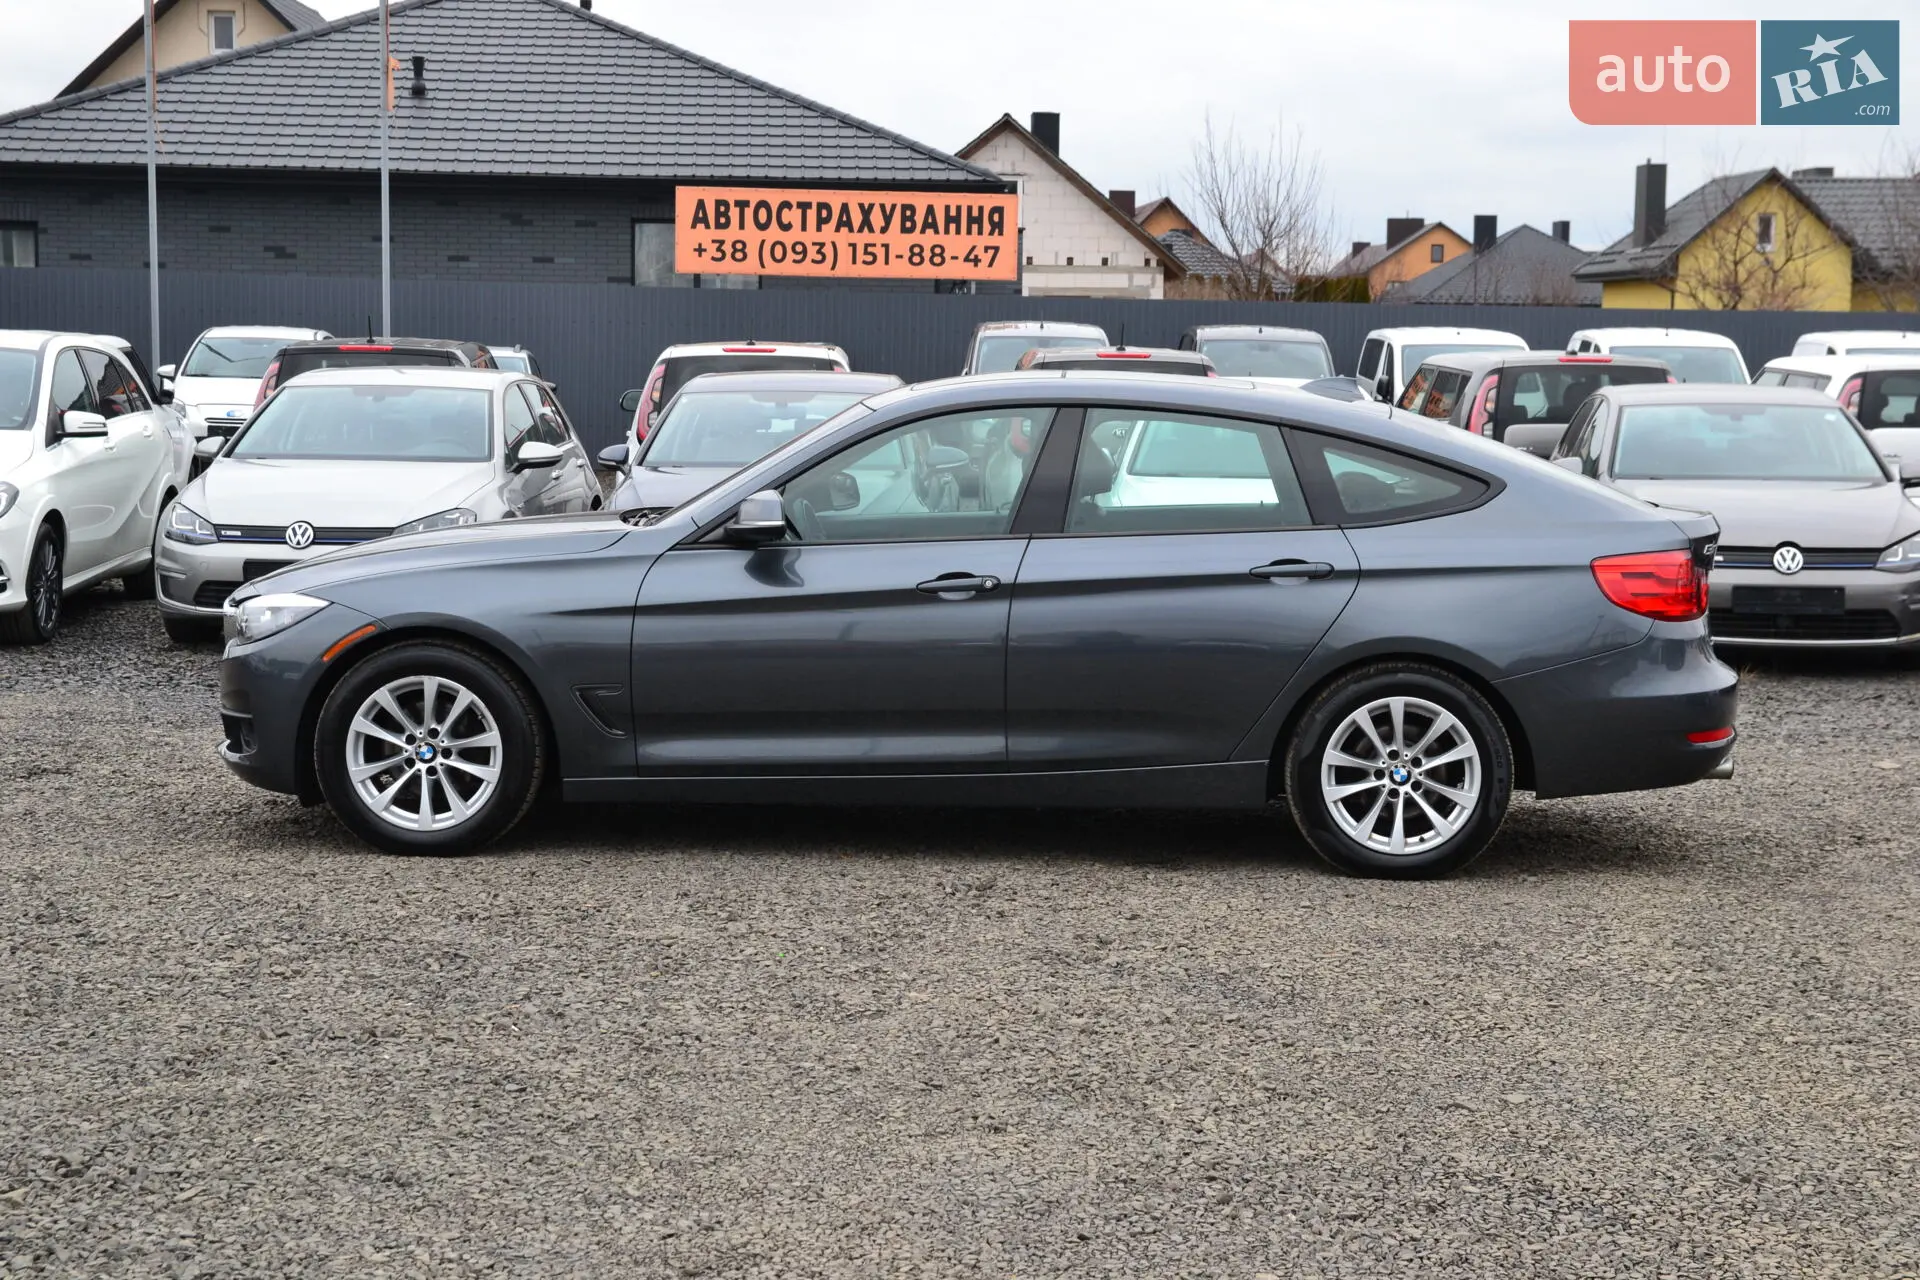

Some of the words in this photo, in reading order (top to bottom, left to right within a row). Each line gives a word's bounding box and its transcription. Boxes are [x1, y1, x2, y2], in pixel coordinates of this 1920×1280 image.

[690, 198, 1005, 237] АВТОСТРАХУВАННЯ
[693, 239, 748, 263] +38
[758, 239, 839, 271] (093)
[847, 242, 1001, 268] 151-88-47
